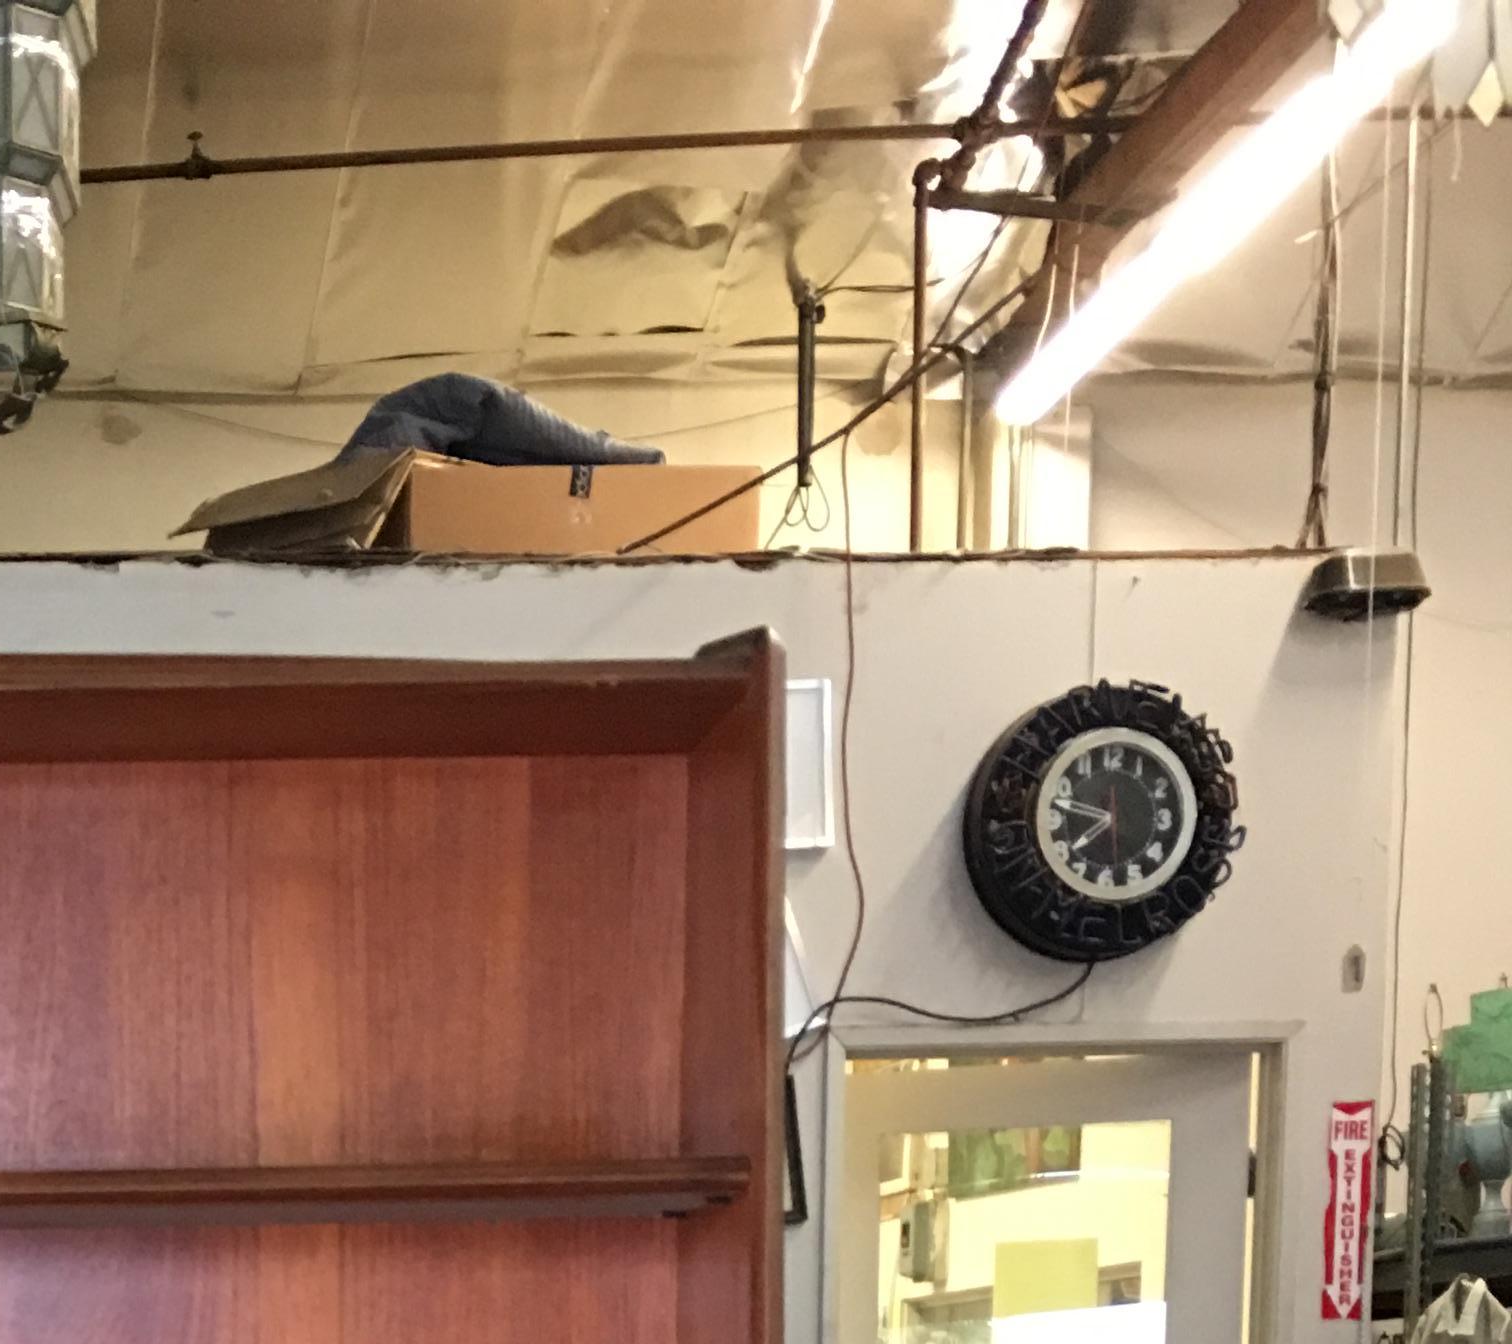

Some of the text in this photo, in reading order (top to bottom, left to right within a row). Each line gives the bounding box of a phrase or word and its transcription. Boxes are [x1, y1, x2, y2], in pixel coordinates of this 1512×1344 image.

[1077, 752, 1092, 779] 11
[1103, 747, 1124, 772] 12
[1136, 756, 1144, 777] 1
[1155, 777, 1168, 799] 2
[1157, 808, 1172, 831] 3
[1146, 841, 1164, 863] 4
[1334, 1120, 1369, 1141] FIRE
[1338, 1149, 1358, 1306] EXTINGUISHER
